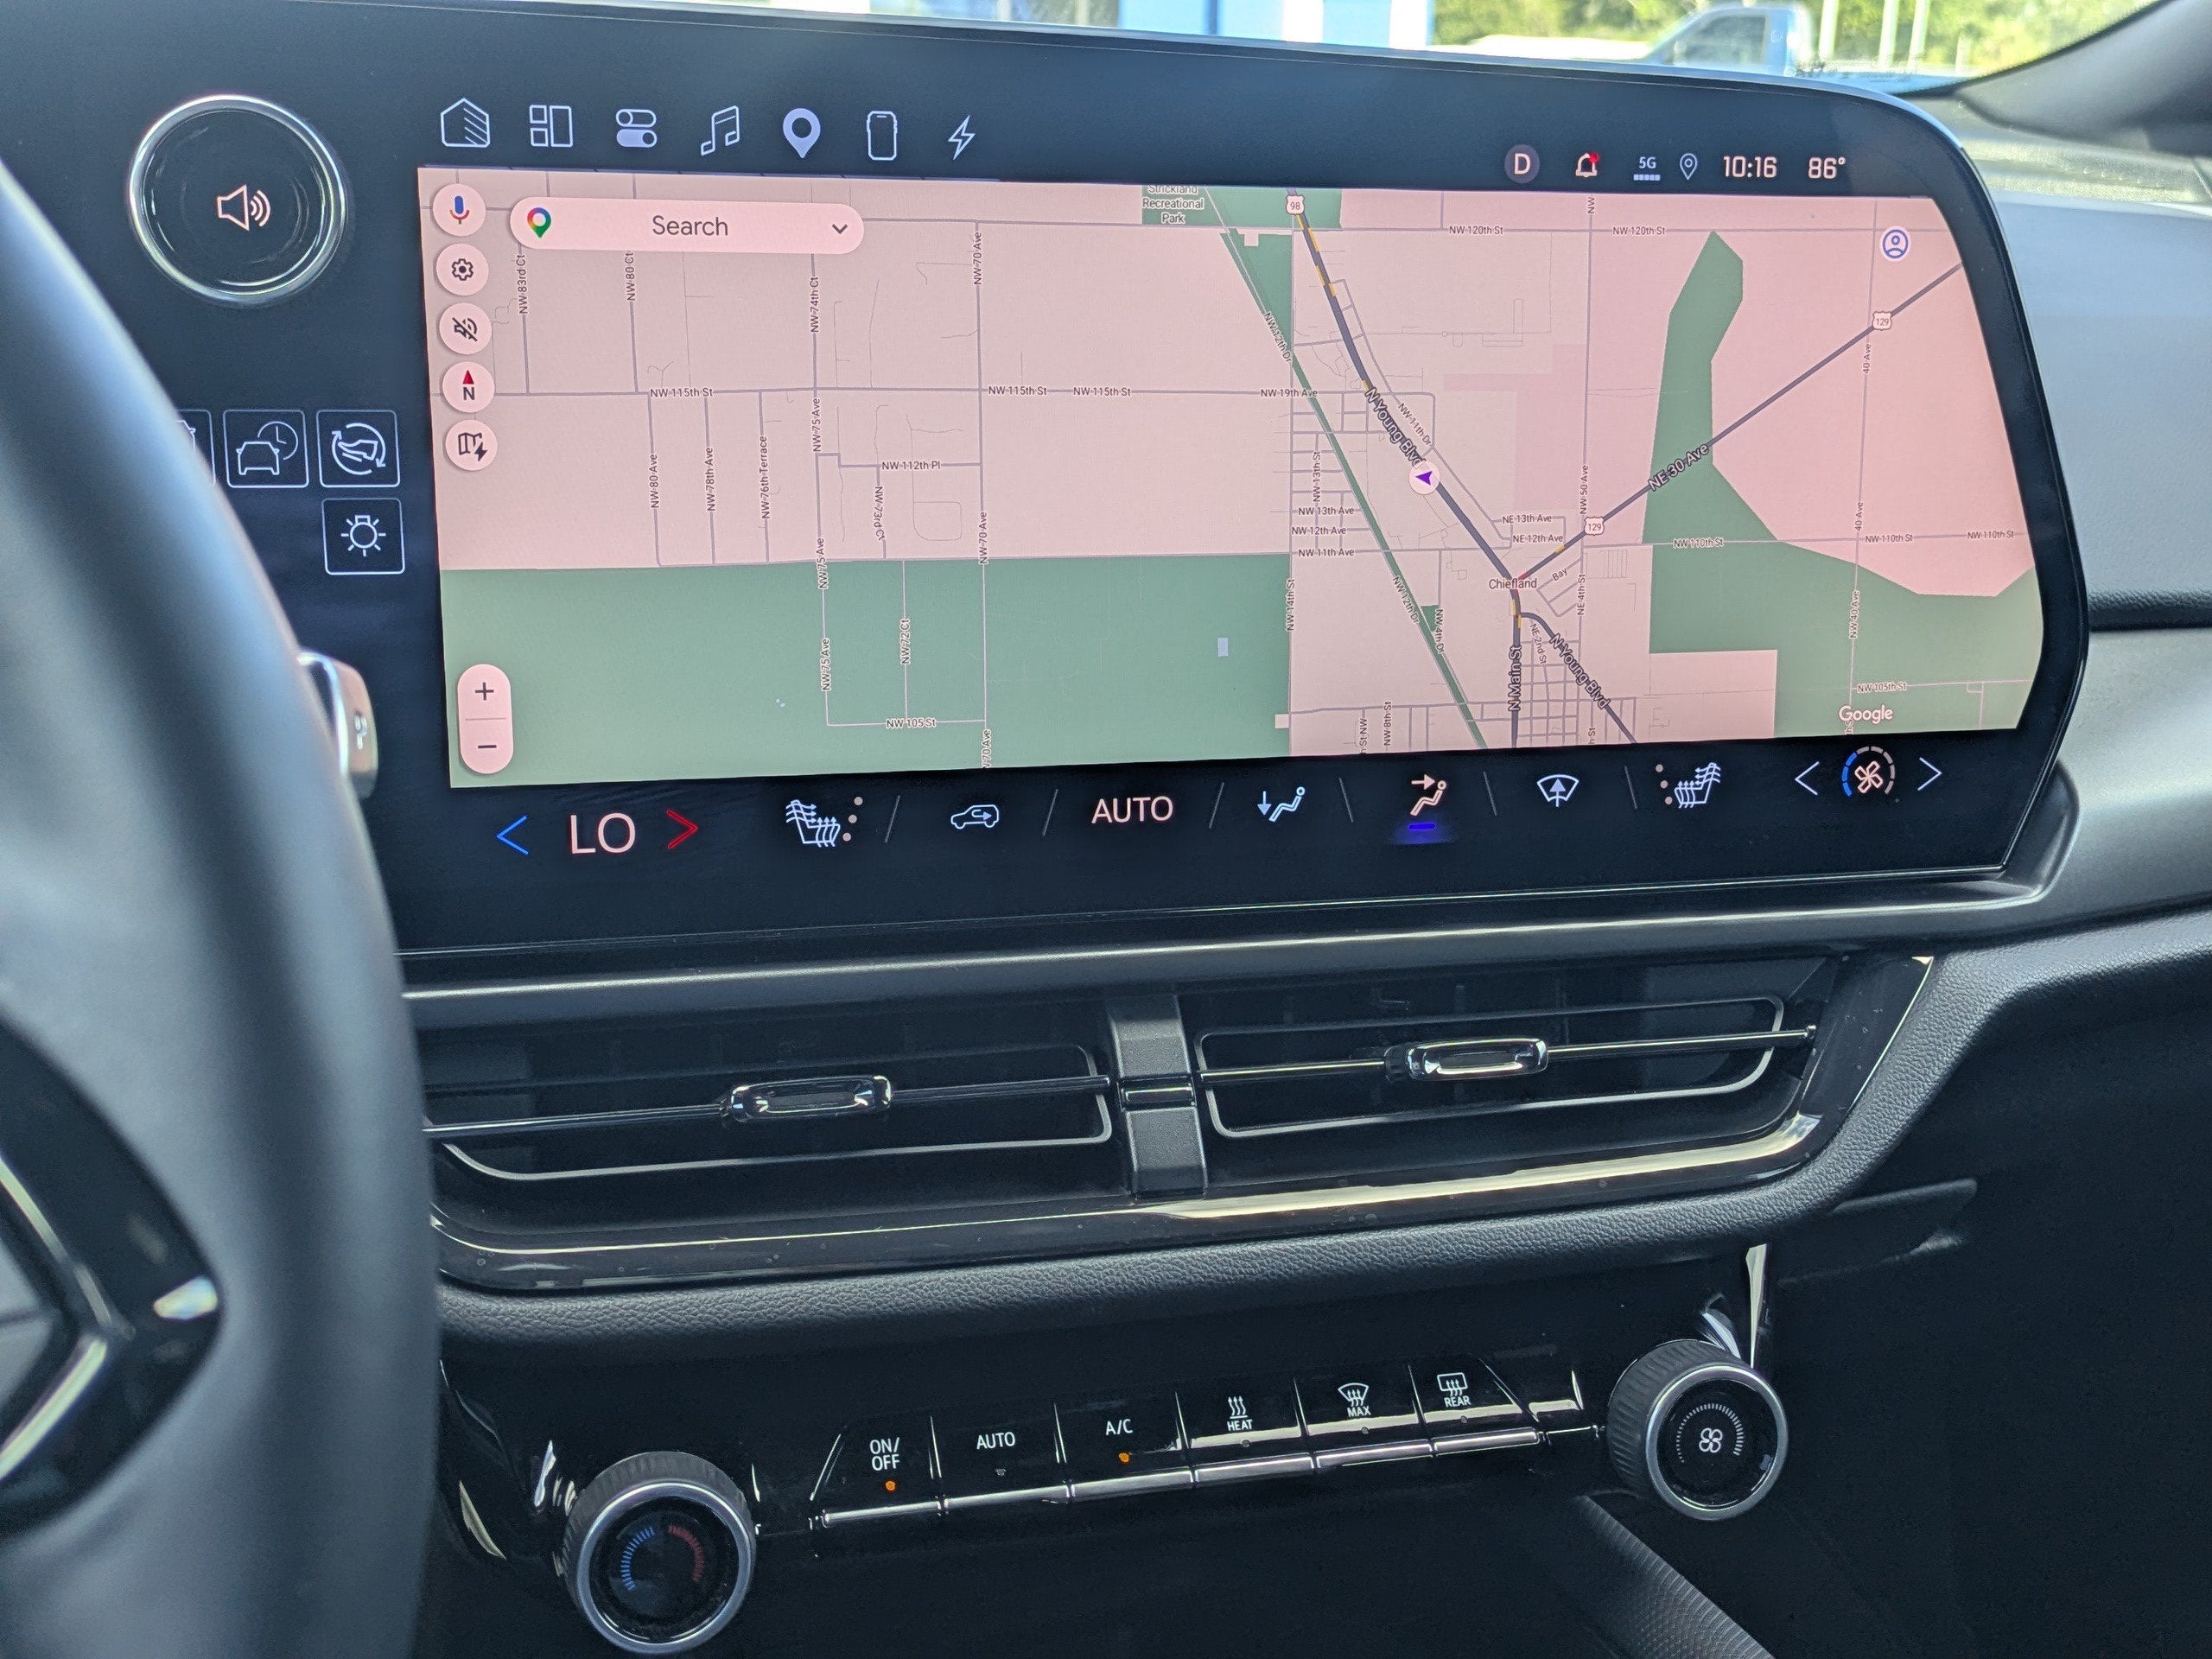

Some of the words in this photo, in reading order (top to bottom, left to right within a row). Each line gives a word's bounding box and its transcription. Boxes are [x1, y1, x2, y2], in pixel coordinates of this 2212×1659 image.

[1514, 152, 1531, 175] D
[1638, 156, 1656, 169] 5G
[1723, 156, 1777, 178] 10:16
[1142, 197, 1204, 209] Recreational
[1290, 201, 1300, 211] 98
[1587, 196, 1595, 213] NW
[652, 214, 729, 238] Search
[1161, 213, 1185, 224] Park
[1449, 226, 1465, 235] NW
[1467, 226, 1491, 235] 120th
[1493, 226, 1503, 234] St
[1612, 226, 1628, 235] NW
[1630, 226, 1654, 235] 120th
[1656, 226, 1665, 235] St
[973, 232, 982, 250] Ave
[516, 254, 525, 267] Ct
[625, 252, 634, 264] Ct
[973, 251, 982, 266] 70
[625, 267, 635, 279] 80
[974, 267, 982, 285] NW
[517, 269, 527, 293] 83rd
[810, 276, 818, 288] Ct
[626, 283, 635, 302] NW
[518, 296, 528, 315] NW
[810, 289, 819, 313] 74th
[810, 315, 819, 333] NW
[1875, 317, 1889, 327] 129
[1263, 312, 1276, 333] NW
[1272, 332, 1287, 353] 12th
[1282, 350, 1292, 363] Dr
[1863, 362, 1870, 374] 40
[463, 386, 475, 401] N
[650, 389, 668, 397] NW
[671, 388, 700, 397] 115th
[702, 387, 713, 397] St
[988, 386, 1006, 395] NW
[1008, 386, 1034, 395] 115th
[1036, 386, 1047, 395] St
[1073, 387, 1090, 396] NW
[1093, 387, 1119, 396] 115th
[1121, 387, 1131, 397] St
[1280, 388, 1299, 397] 19th
[812, 419, 821, 431] 75
[1365, 387, 1377, 403] N
[1374, 398, 1402, 443] Young
[1399, 438, 1426, 467] Blvd
[1397, 403, 1412, 420] NW
[1408, 416, 1425, 436] 11th
[1420, 433, 1432, 446] Dr
[813, 434, 822, 452] NW
[649, 454, 658, 473] Ave
[1313, 452, 1320, 461] St
[882, 461, 899, 470] NW
[902, 461, 929, 470] 112th
[931, 461, 941, 469] Pl
[1580, 465, 1589, 481] Ave
[1648, 471, 1669, 492] NE
[1668, 459, 1684, 476] 30
[1684, 444, 1709, 467] Ave
[650, 475, 658, 487] 80
[705, 468, 715, 492] 78th
[760, 474, 769, 499] 76th
[874, 486, 883, 504] NW
[1313, 485, 1320, 502] NW
[1580, 484, 1588, 495] 50
[651, 491, 659, 508] NW
[706, 494, 715, 512] NW
[1580, 498, 1587, 514] NW
[761, 501, 770, 519] NW
[874, 505, 883, 527] 73rd
[978, 512, 987, 531] Ave
[1516, 515, 1535, 524] 13th
[1587, 523, 1601, 531] 129
[875, 529, 886, 541] Ct
[979, 532, 988, 544] 70
[1310, 526, 1329, 535] 12th
[1865, 535, 1879, 543] NW
[1882, 534, 1903, 543] 110th
[1904, 533, 1912, 542] St
[1983, 530, 2004, 538] 110th
[1674, 539, 1688, 548] NW
[1690, 538, 1712, 548] 110th
[1713, 537, 1724, 546] St
[980, 547, 988, 564] NW
[1316, 548, 1336, 556] 11th
[1552, 568, 1568, 582] Bay
[1578, 574, 1586, 584] St
[1287, 578, 1295, 588] St
[1489, 578, 1537, 589] Chiefland
[1287, 589, 1295, 613] 14th
[1577, 586, 1586, 601] 4th
[1851, 590, 1859, 607] Ave
[1577, 602, 1585, 615] NE
[1850, 609, 1859, 620] 40
[900, 620, 910, 631] Ct
[1287, 614, 1294, 631] NW
[901, 632, 910, 644] 72
[1849, 622, 1857, 639] NW
[821, 639, 830, 657] Ave
[901, 646, 910, 664] NW
[1509, 645, 1522, 658] St
[821, 658, 830, 671] 75
[1551, 633, 1562, 649] N
[1560, 645, 1589, 685] Young
[1586, 680, 1611, 709] Blvd
[822, 673, 830, 690] NW
[1509, 659, 1522, 696] Main
[1857, 684, 1872, 693] NW
[1874, 683, 1896, 692] 105th
[1897, 682, 1906, 690] St
[1384, 702, 1392, 711] St
[1508, 698, 1521, 711] N
[1383, 713, 1392, 728] 8th
[1838, 704, 1894, 725] Google
[886, 719, 903, 728] NW
[906, 719, 924, 728] 105
[925, 718, 935, 727] St
[1384, 731, 1391, 746] NW
[1090, 795, 1173, 825] AUTO
[568, 812, 637, 855] LO
[1444, 1395, 1471, 1408] REAR
[1346, 1406, 1371, 1418] MAX
[1105, 1418, 1134, 1435] A/C
[1227, 1419, 1253, 1431] HEAT
[869, 1436, 899, 1455] ON/
[976, 1431, 1016, 1450] AUTO
[871, 1453, 899, 1471] OFF
